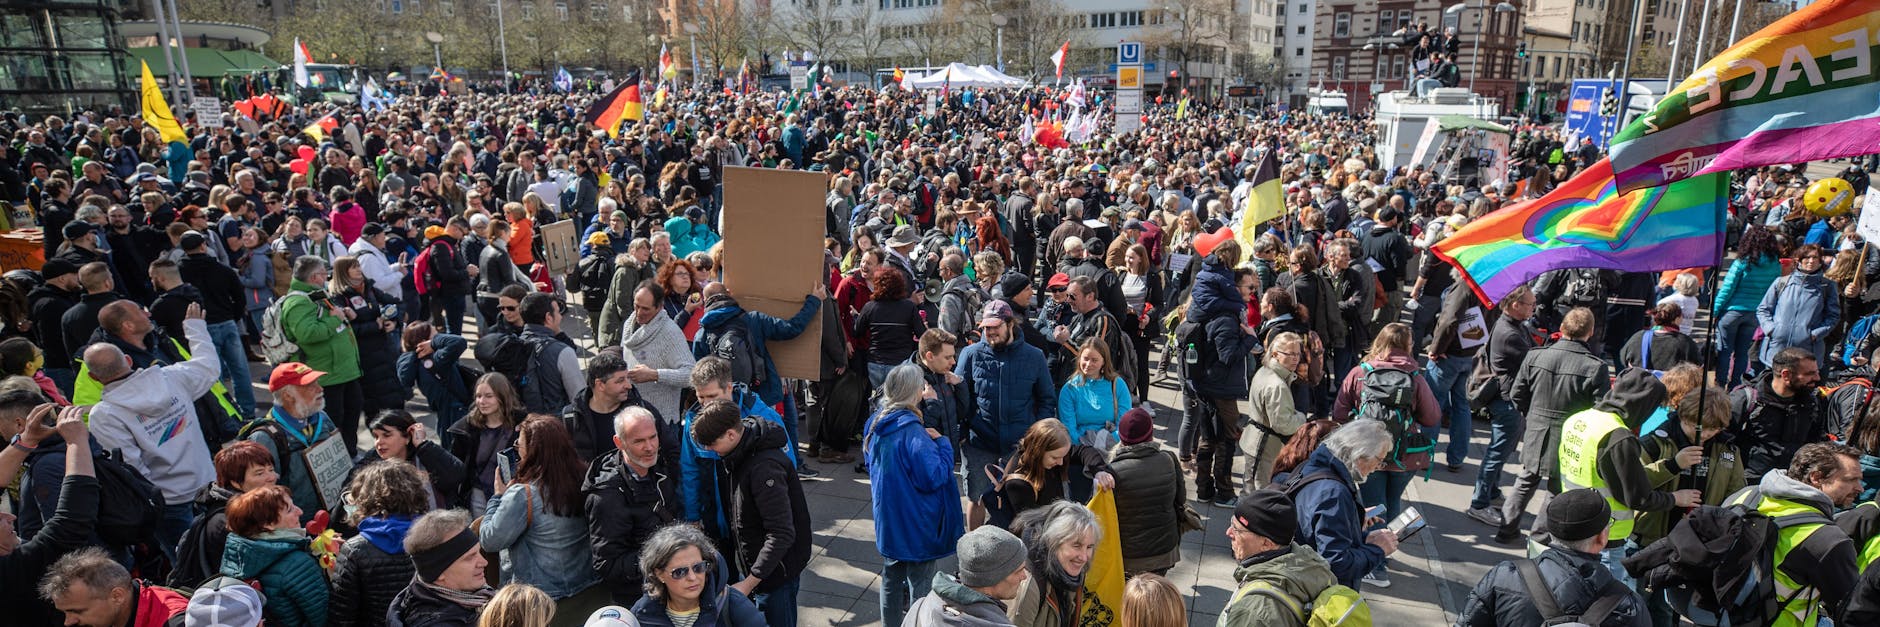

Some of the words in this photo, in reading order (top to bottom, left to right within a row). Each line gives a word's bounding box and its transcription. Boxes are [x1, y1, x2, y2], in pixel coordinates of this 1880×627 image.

[1123, 45, 1136, 59] U
[1573, 419, 1587, 433] Gib
[1565, 430, 1584, 447] Gates
[309, 447, 334, 470] Genug
[1563, 443, 1580, 462] keine
